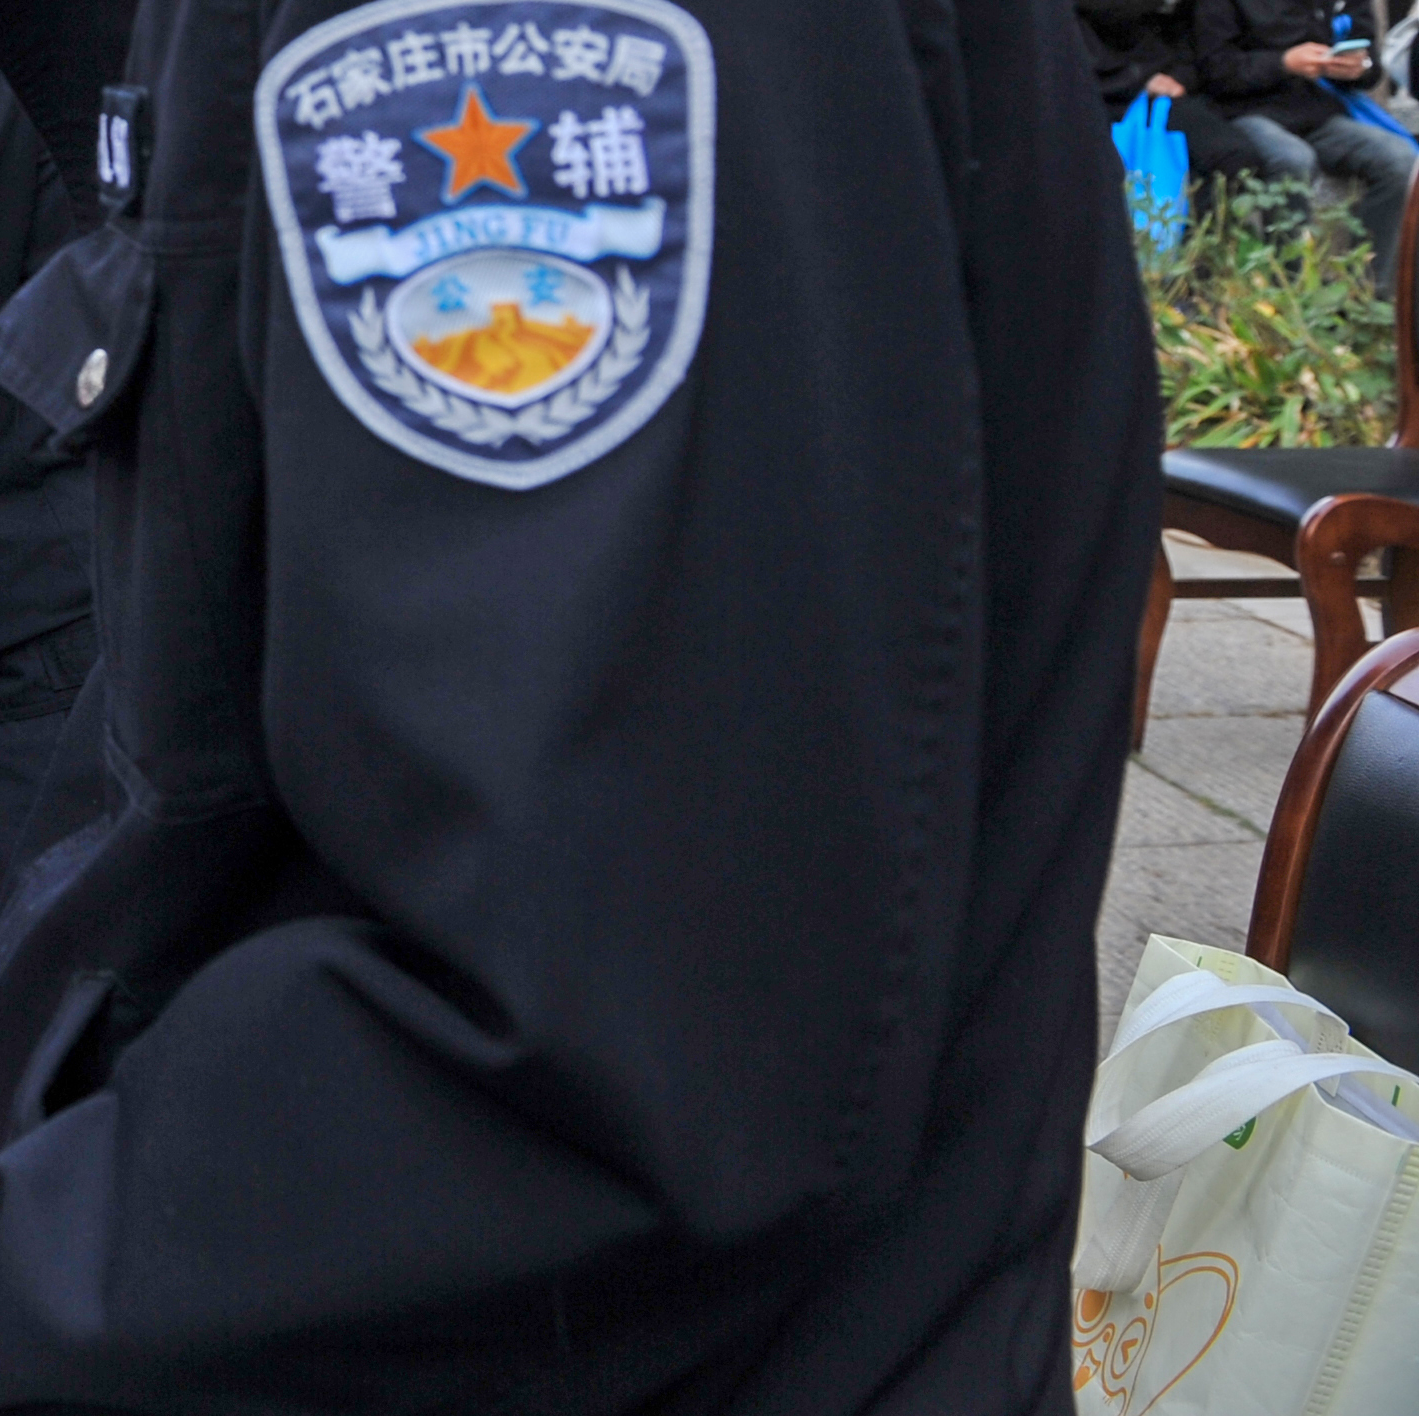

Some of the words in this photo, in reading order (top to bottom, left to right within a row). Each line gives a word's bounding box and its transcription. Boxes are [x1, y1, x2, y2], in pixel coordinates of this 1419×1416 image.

[284, 20, 667, 130] 石家庄市公安局
[315, 130, 407, 223] 警
[547, 104, 650, 199] 辅
[414, 215, 509, 260] JING
[519, 215, 575, 250] FU
